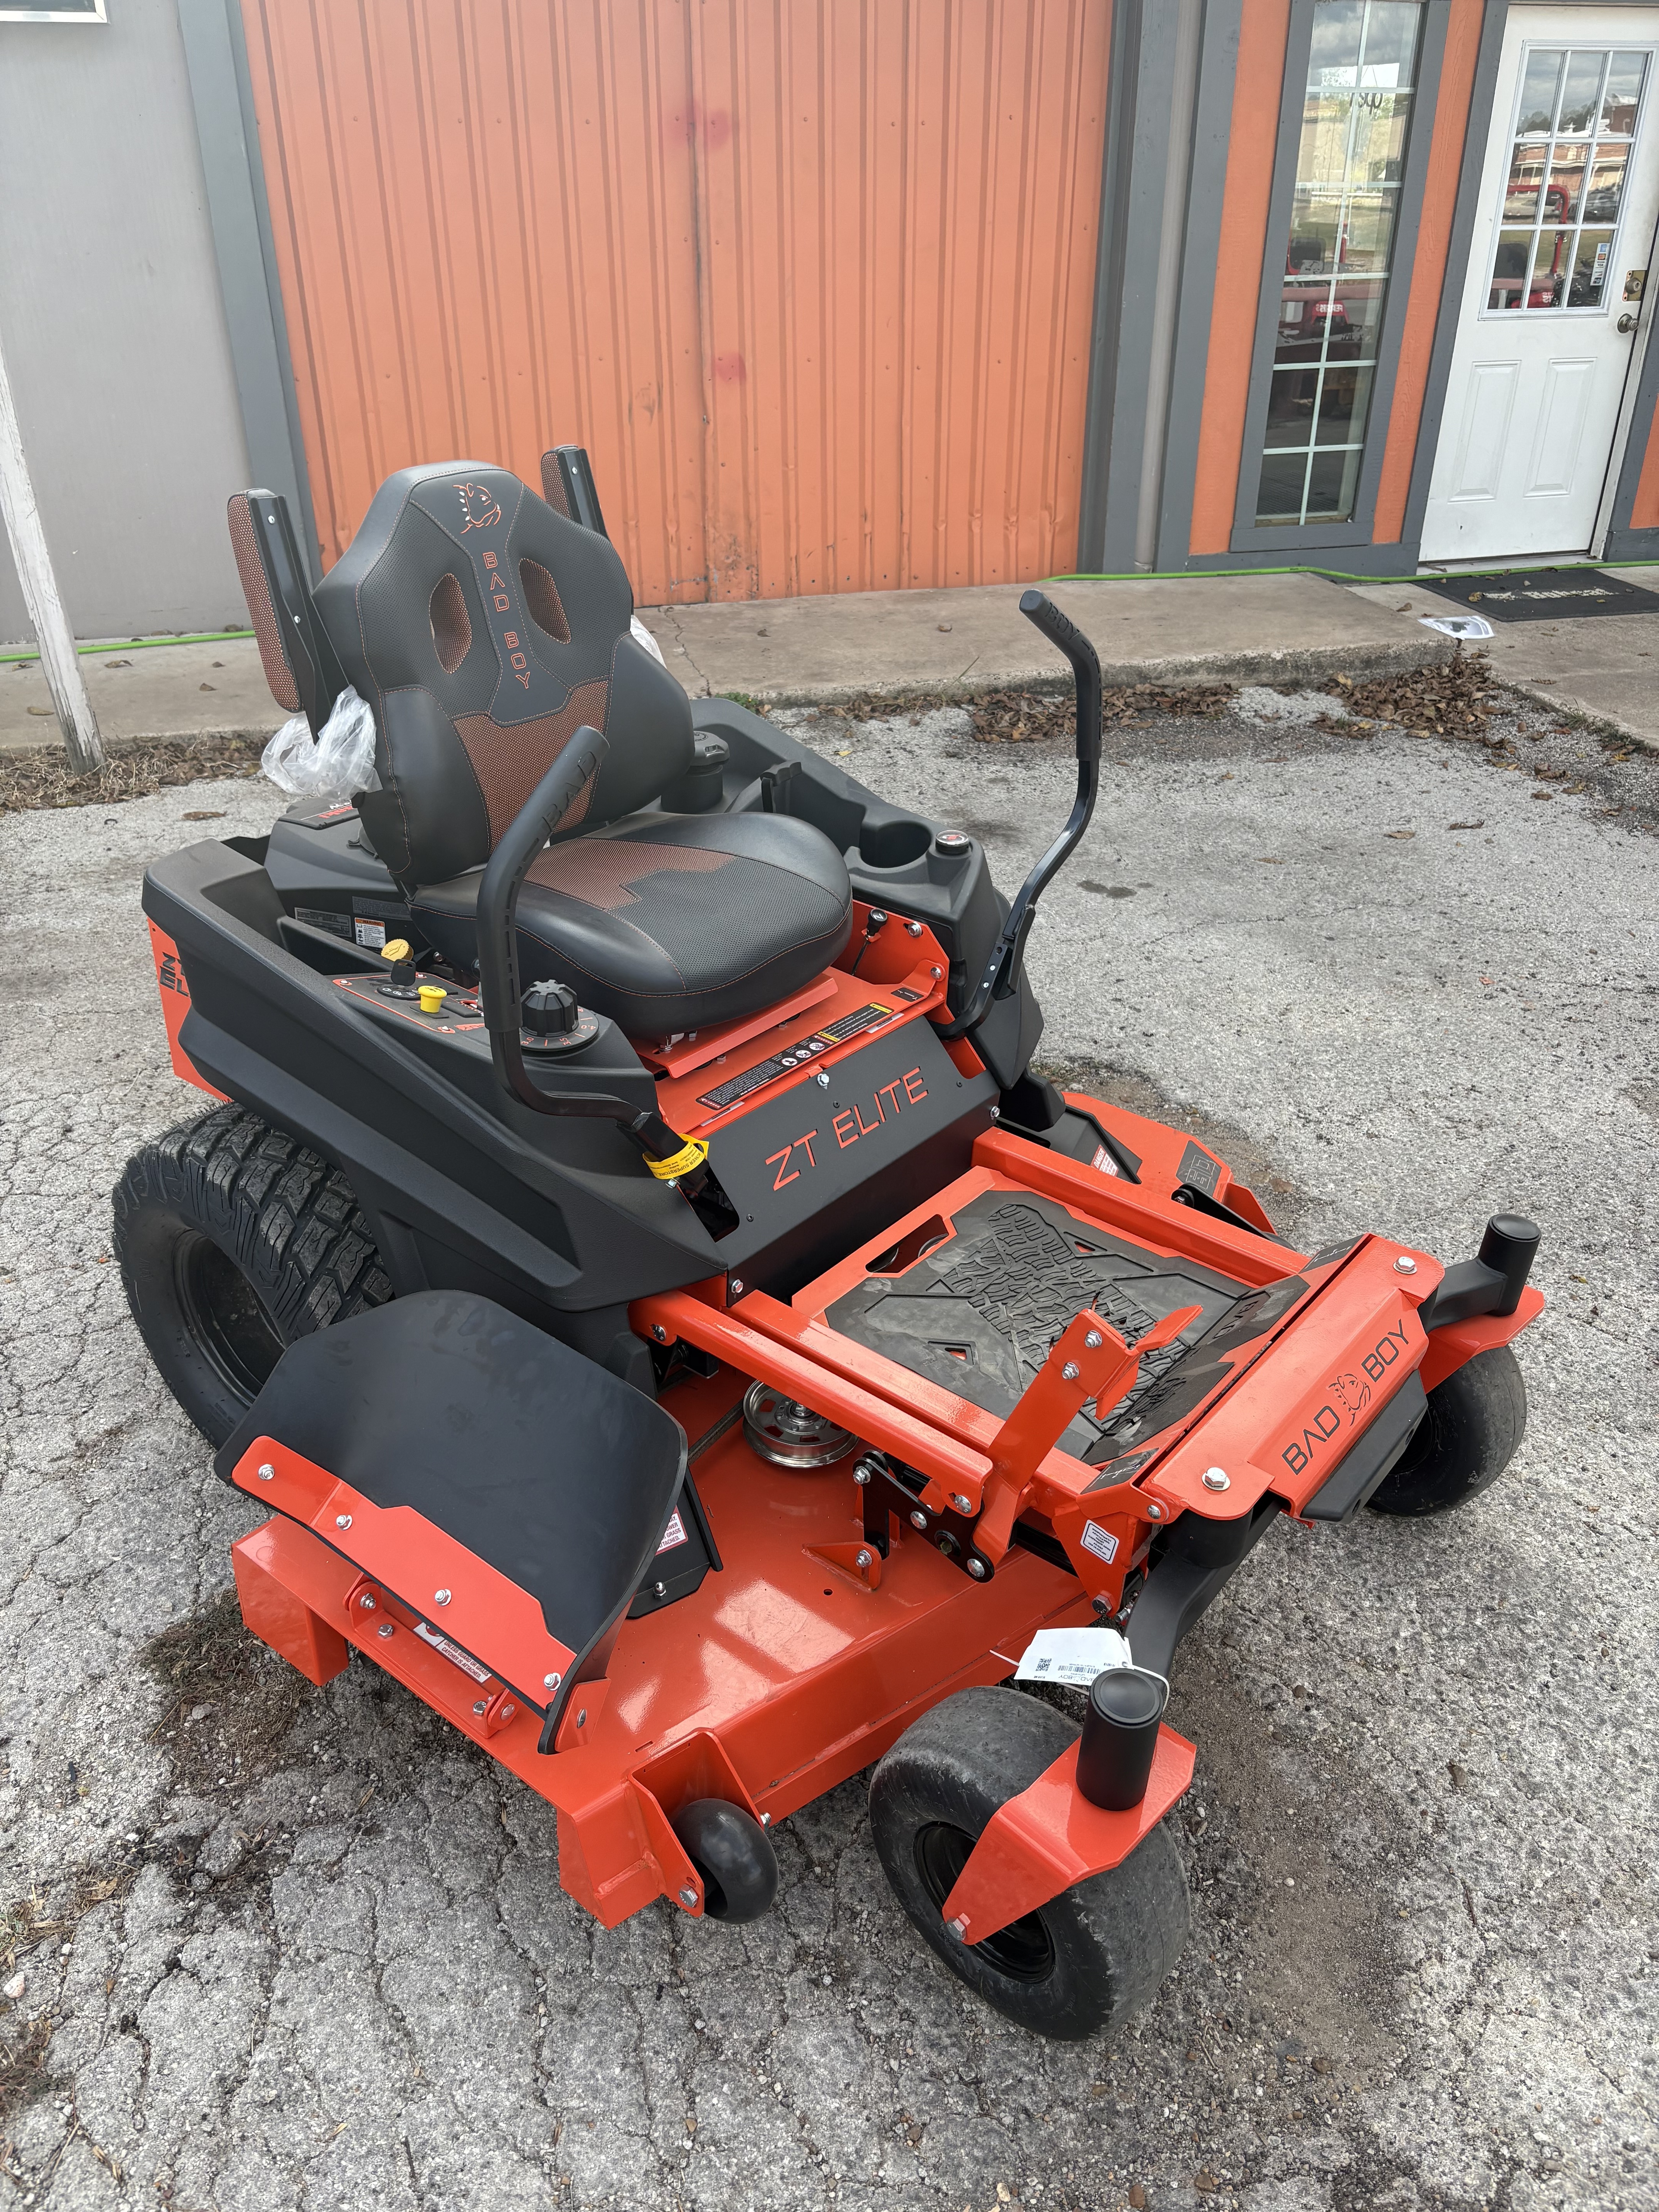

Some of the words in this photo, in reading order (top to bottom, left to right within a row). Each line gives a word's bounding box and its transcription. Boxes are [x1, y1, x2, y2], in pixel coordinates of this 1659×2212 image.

[483, 551, 511, 612] BAD
[504, 632, 532, 689] BOY
[765, 1129, 817, 1191] ZT
[833, 1066, 929, 1149] ELITE
[1094, 1147, 1105, 1169] DANGER
[1281, 1405, 1340, 1475] BAD
[1361, 1319, 1409, 1383] BOY
[666, 1522, 678, 1531] OWER
[666, 1528, 681, 1538] GRASS
[441, 1647, 459, 1661] CATCHER
[461, 1662, 481, 1679] ATTACHED.
[444, 1641, 460, 1654] UNLESS
[458, 1650, 472, 1663] GUARD
